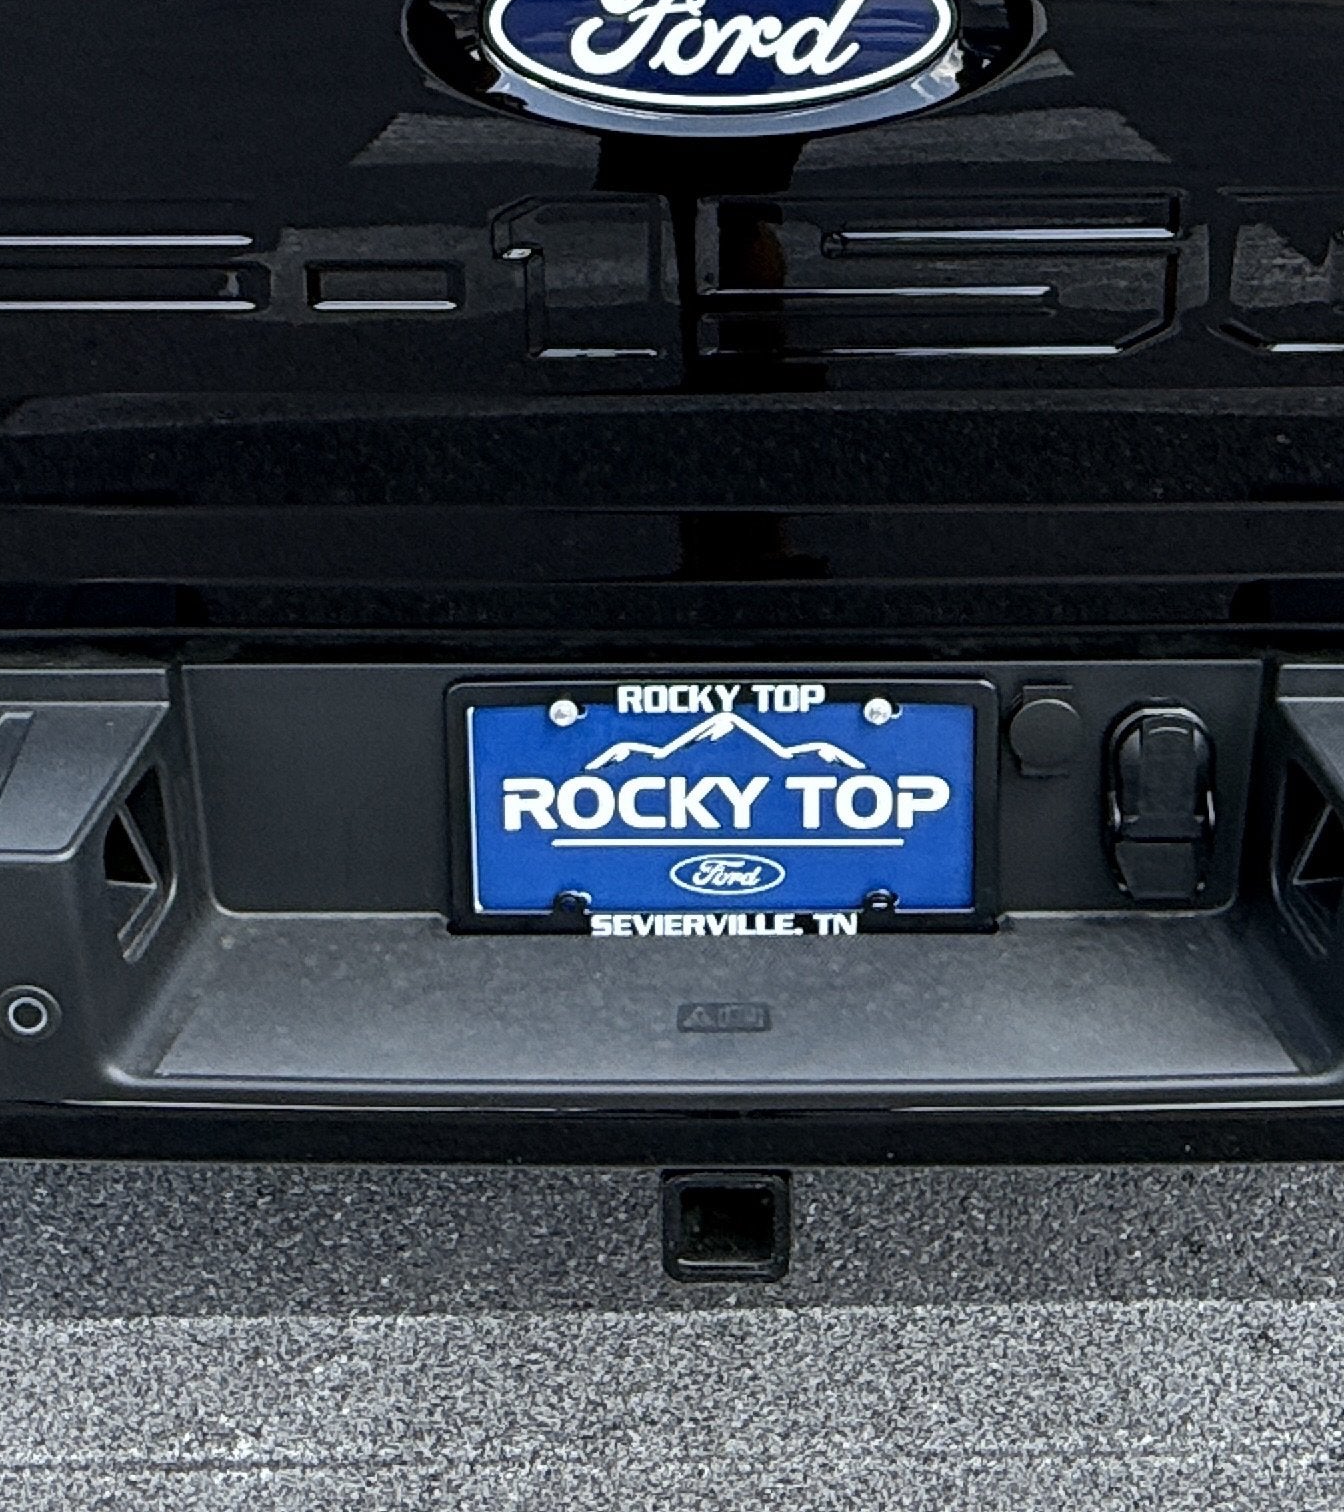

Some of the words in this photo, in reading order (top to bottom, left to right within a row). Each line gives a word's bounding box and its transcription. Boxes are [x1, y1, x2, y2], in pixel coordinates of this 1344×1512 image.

[617, 684, 740, 714] ROCKY
[751, 684, 826, 714] TOP
[502, 776, 772, 831] ROCKY
[785, 776, 951, 831] TOP
[692, 860, 762, 886] Ford
[812, 913, 857, 936] TN
